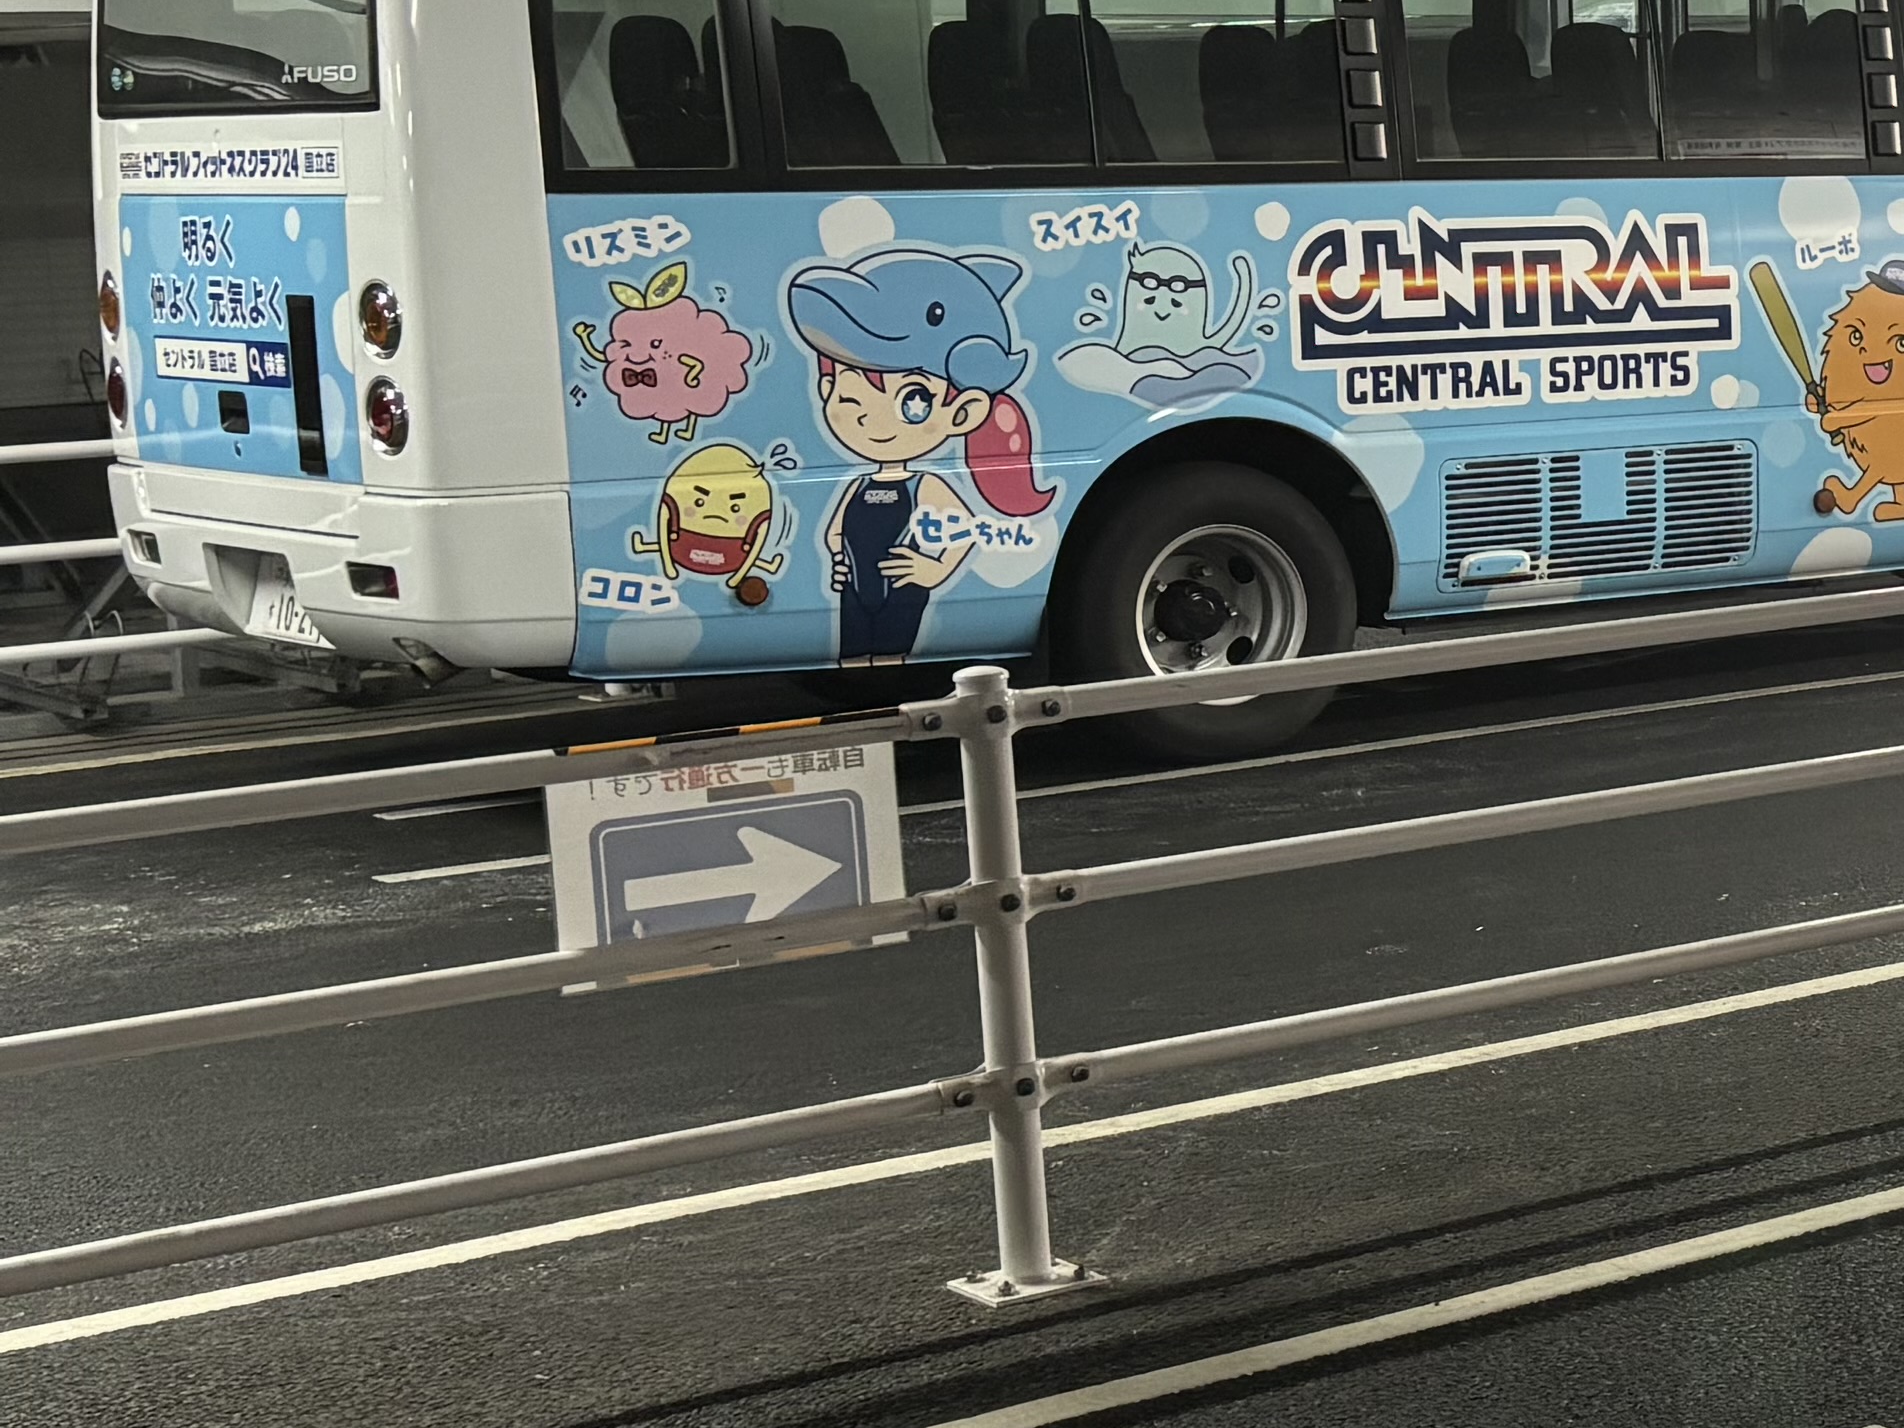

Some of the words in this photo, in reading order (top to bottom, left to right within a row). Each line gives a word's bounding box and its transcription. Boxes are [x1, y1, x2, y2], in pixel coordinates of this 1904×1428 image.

[293, 64, 357, 84] FUSO
[304, 151, 336, 173] 国立店
[181, 217, 235, 266] 明るく
[571, 220, 683, 260] リズミン
[1037, 207, 1135, 244] スイスイ
[151, 275, 200, 326] 仲よく
[208, 277, 285, 330] 元気よく
[1297, 216, 1733, 361] CENTRAL
[163, 347, 205, 370] セントラル
[1347, 360, 1523, 406] CENTRAL
[1548, 351, 1691, 393] SPORTS
[916, 510, 1034, 546] センちゃん
[586, 575, 672, 606] コロン
